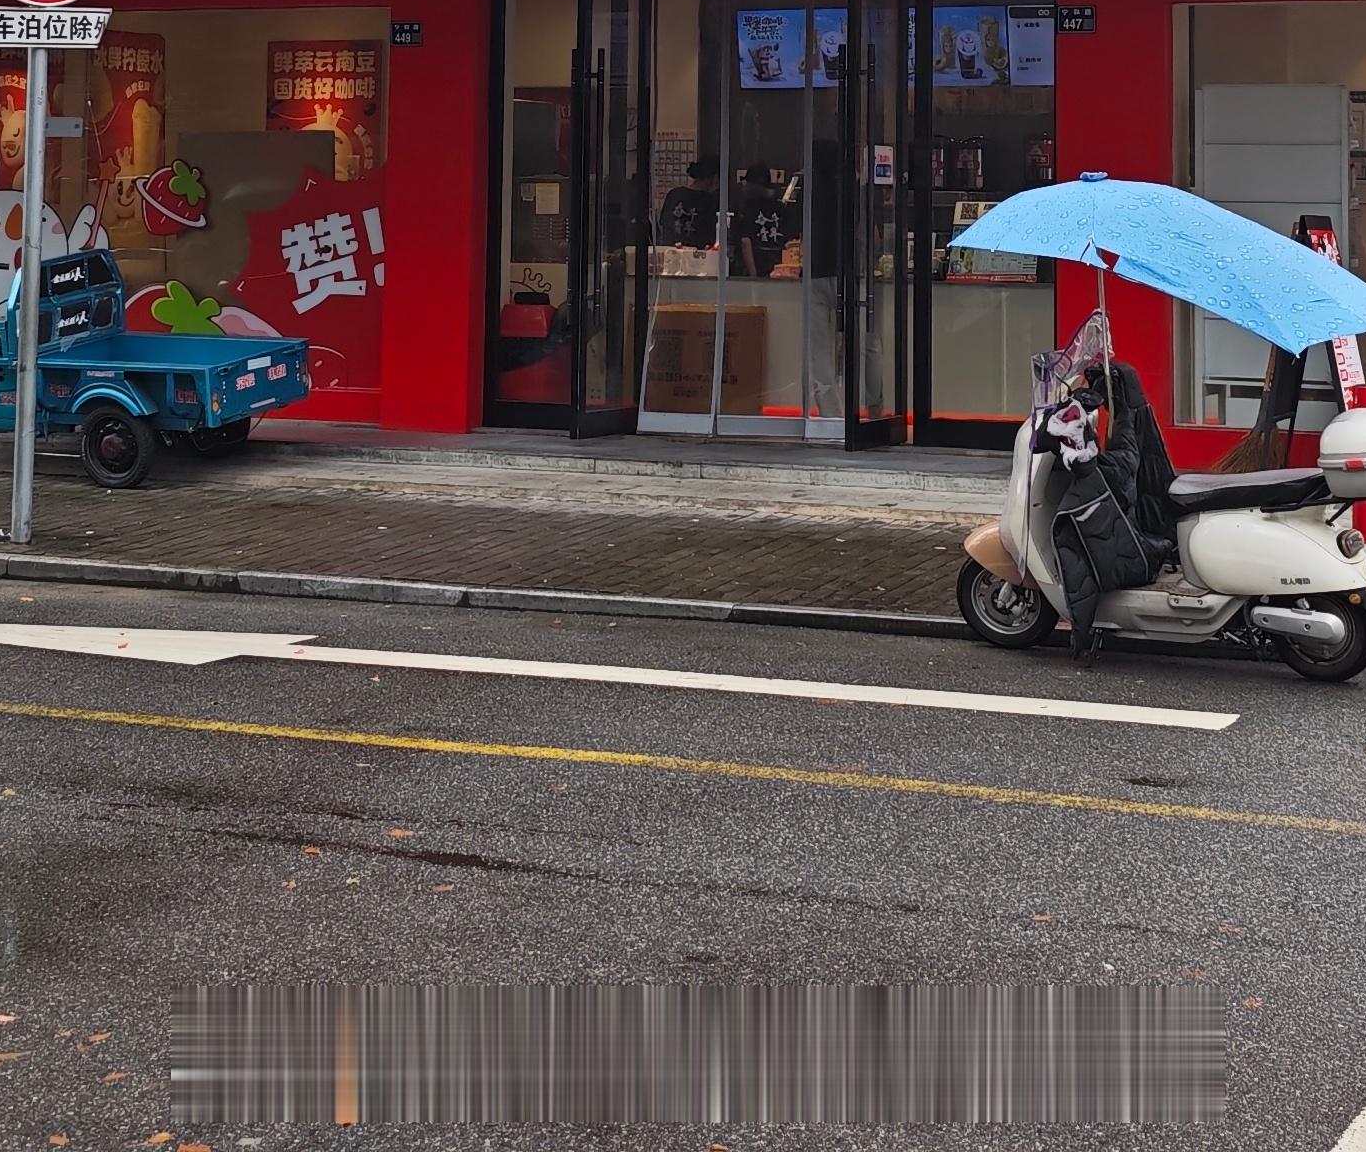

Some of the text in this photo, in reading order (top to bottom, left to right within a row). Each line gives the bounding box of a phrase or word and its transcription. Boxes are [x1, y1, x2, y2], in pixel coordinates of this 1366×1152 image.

[1063, 18, 1083, 30] 447
[394, 32, 411, 44] 449
[273, 51, 376, 73] 鲜萃云南豆
[274, 77, 376, 100] 国货好咖啡
